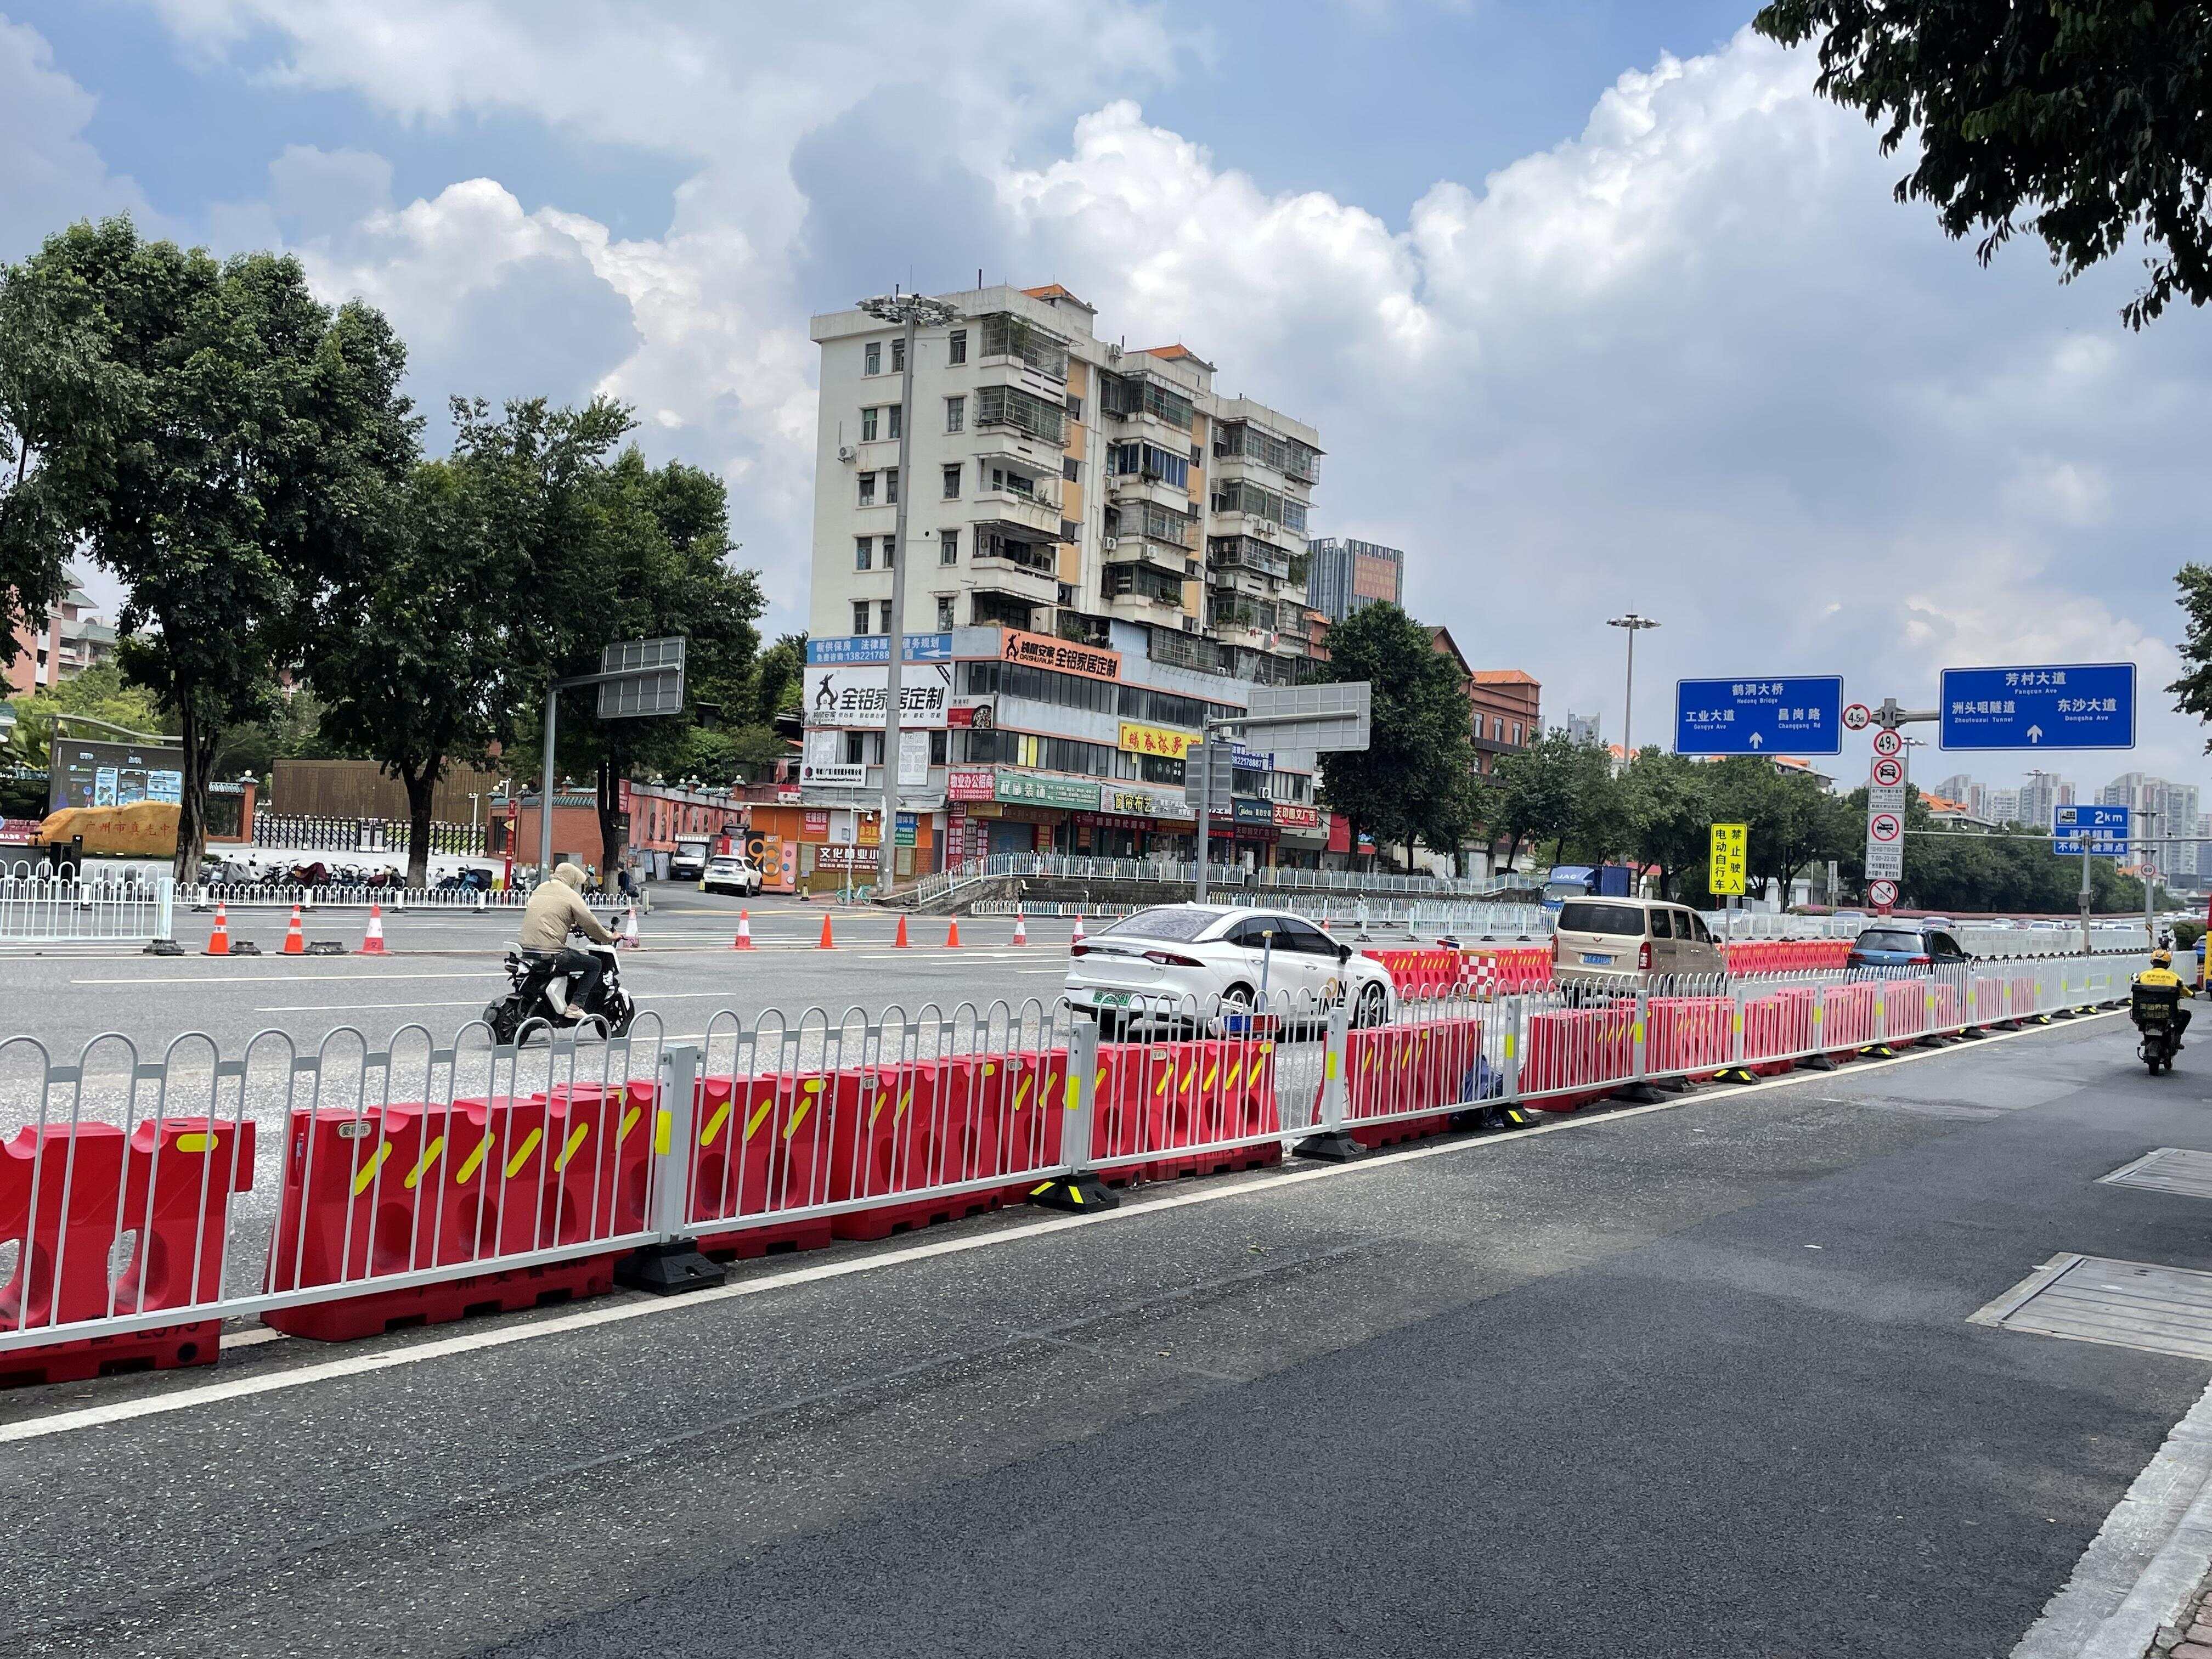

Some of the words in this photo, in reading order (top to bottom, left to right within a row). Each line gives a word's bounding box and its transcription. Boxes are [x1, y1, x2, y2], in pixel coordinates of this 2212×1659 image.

[816, 640, 851, 653] 断供保房
[861, 639, 890, 651] 法律服
[902, 636, 939, 650] 债务规划
[1055, 647, 1118, 678] 全铝家居定制
[2006, 672, 2067, 686] 芳村大道
[1732, 683, 1784, 696] 鹤洞大桥
[840, 687, 945, 710] 全铝家居定制
[2057, 698, 2117, 712] 东沙大道
[1778, 708, 1821, 721] 昌岗路
[1952, 701, 2016, 715] 洲头咀隧道
[1685, 709, 1735, 723] 工业大道
[1879, 736, 1895, 750] 49t
[950, 774, 994, 789] 物业办公招商
[1115, 793, 1152, 813] 窗帘布艺
[1238, 805, 1253, 816] Midea
[1274, 806, 1316, 822] 天印图文广告
[2095, 811, 2123, 824] 2km
[1714, 828, 1726, 890] 电动自行车
[1730, 829, 1742, 890] 禁止驶入
